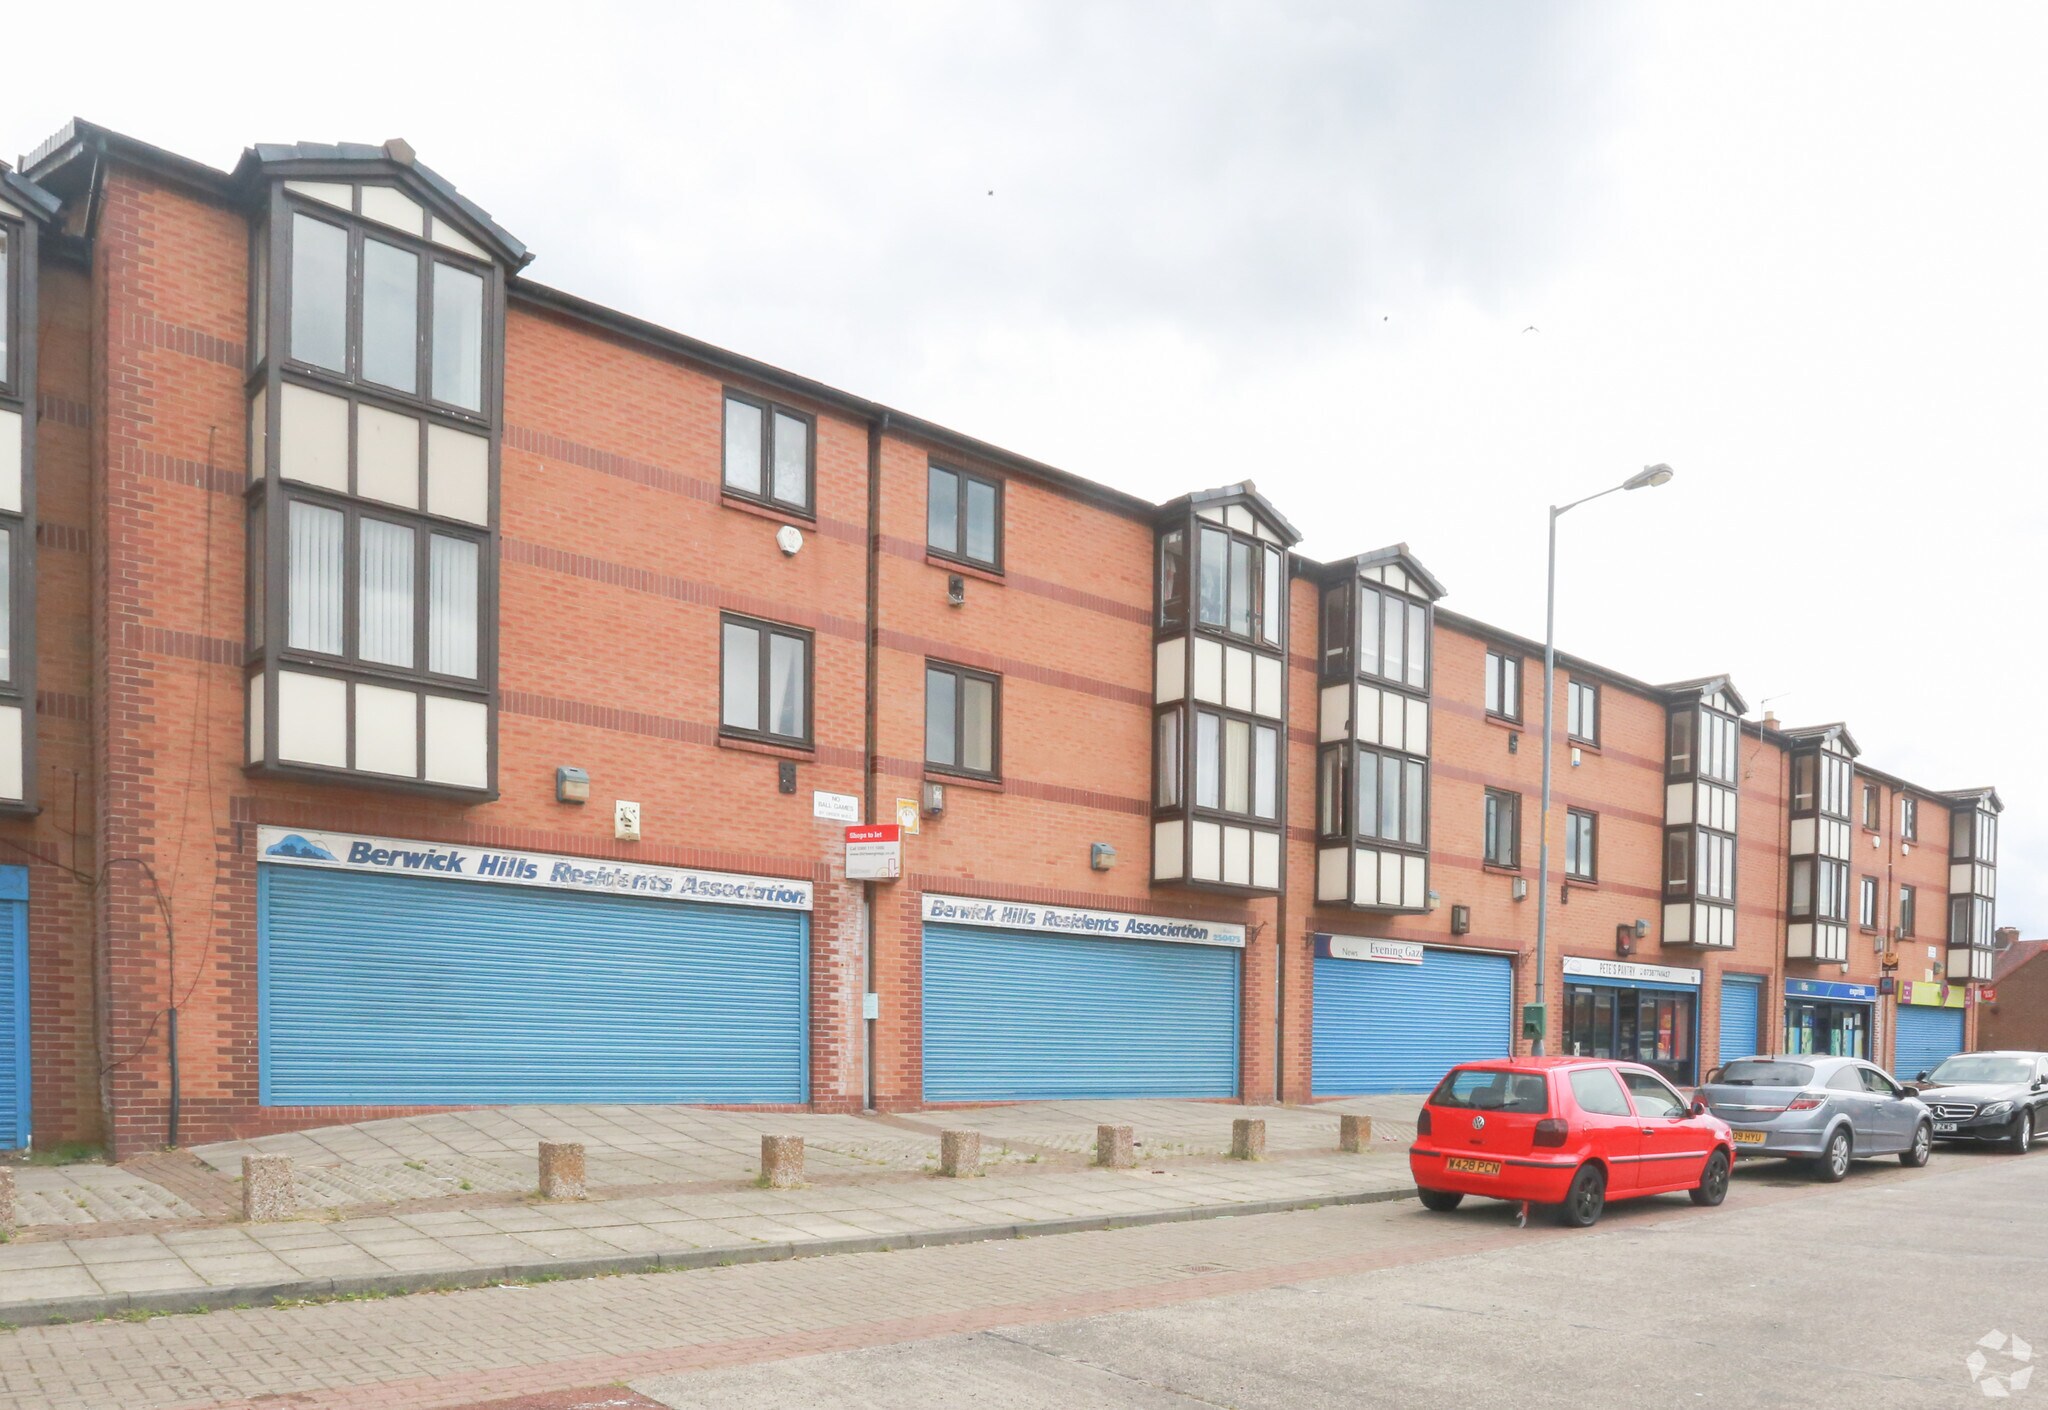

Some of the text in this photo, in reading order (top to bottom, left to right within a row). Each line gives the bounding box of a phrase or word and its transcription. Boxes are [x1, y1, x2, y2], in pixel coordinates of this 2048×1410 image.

[833, 804, 854, 812] GAMES
[849, 832, 867, 840] Shops
[347, 841, 807, 905] Berwick Hills Residents Association
[930, 900, 1209, 940] Berwick Hills Residents Association
[1341, 947, 1358, 957] News
[1370, 942, 1403, 960] Evening
[1599, 963, 1617, 974] PETE'S
[1617, 965, 1636, 976] PANTRY
[1744, 1132, 1762, 1142] HYU
[1448, 1158, 1500, 1174] W428 PCN
